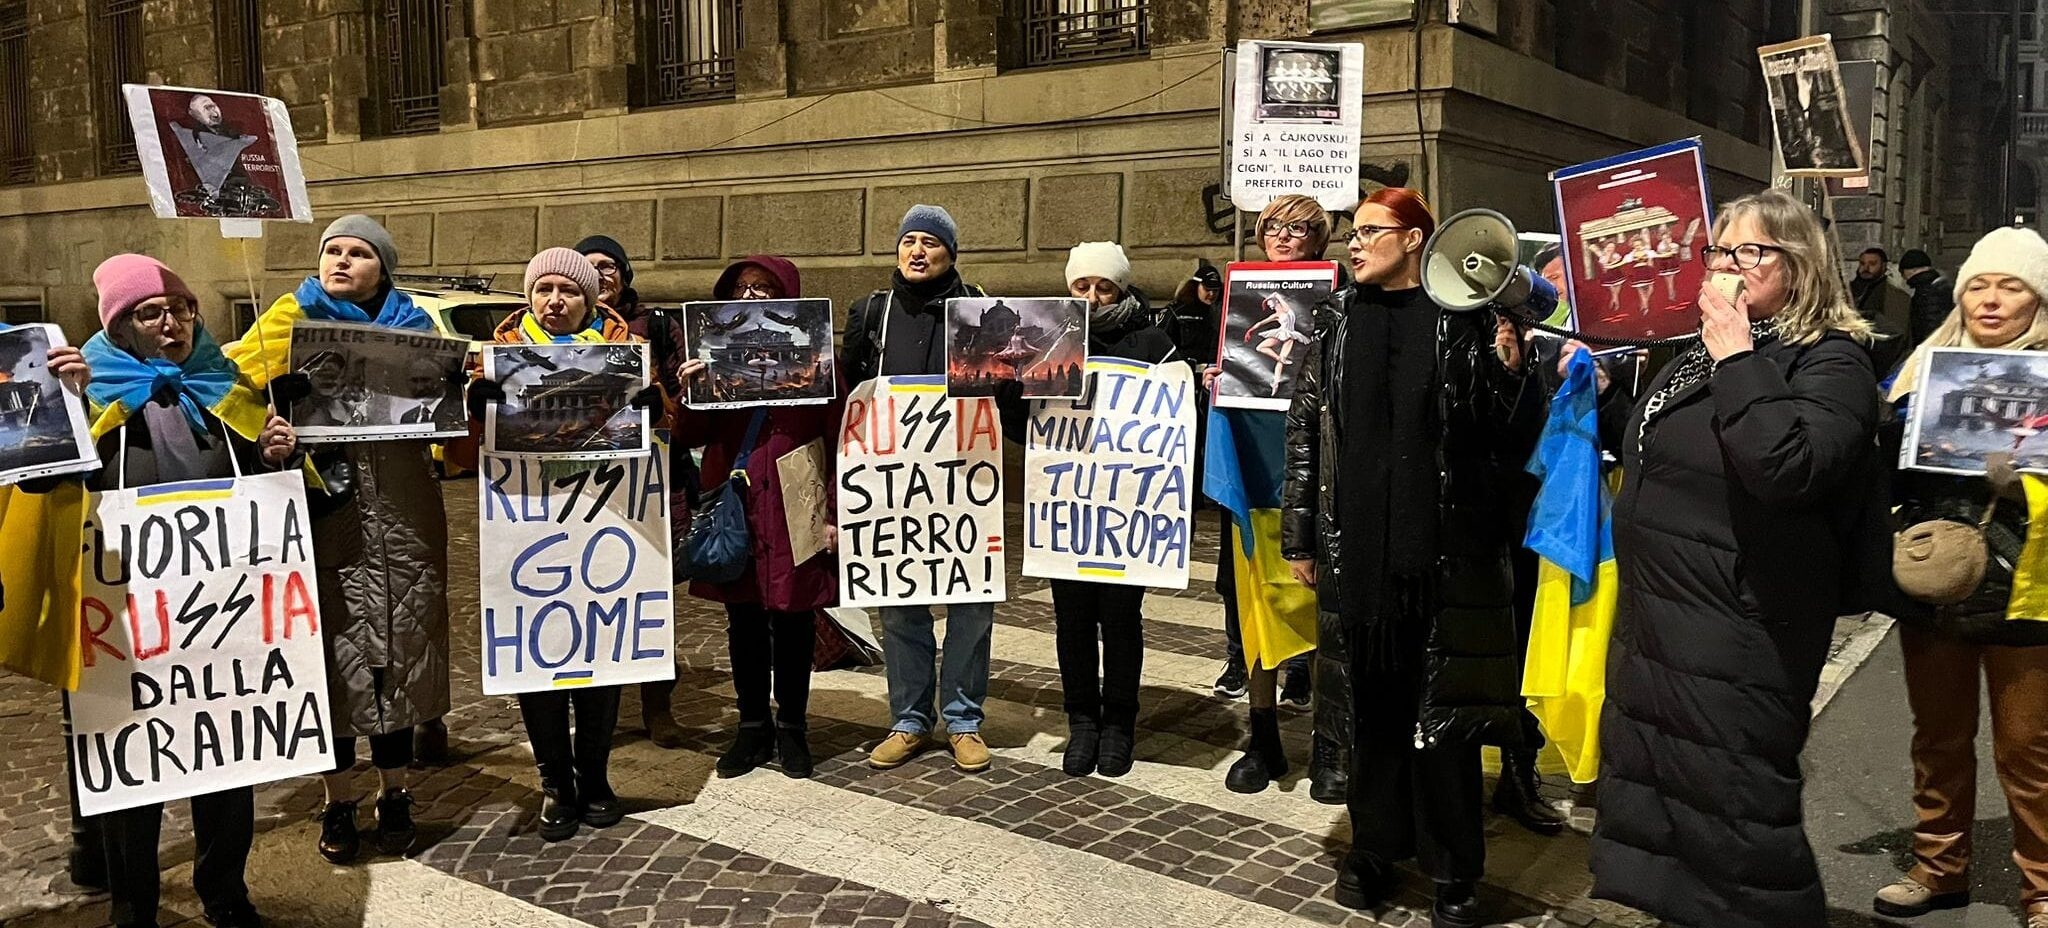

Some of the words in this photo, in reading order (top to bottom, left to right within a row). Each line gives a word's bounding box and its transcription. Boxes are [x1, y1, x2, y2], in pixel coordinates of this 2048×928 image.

[1259, 149, 1267, 157] A
[1294, 149, 1324, 158] LAGO
[1330, 150, 1348, 159] DEI
[1263, 133, 1271, 142] A
[1245, 180, 1303, 188] PREFERITO
[1312, 180, 1344, 189] DEGLI
[1283, 164, 1292, 172] IL
[1298, 165, 1353, 174] BALLETTO
[1245, 281, 1280, 289] Russian
[1281, 281, 1313, 289] Culture
[293, 327, 367, 345] HITLER
[395, 332, 459, 352] PUTIN
[1040, 371, 1186, 418] UTIN
[1030, 416, 1187, 464] MINACCIA
[841, 459, 999, 514] STATO
[1043, 462, 1186, 511] TUTTA
[248, 498, 306, 567] LA
[1029, 500, 1187, 569] L'EUROPA
[511, 526, 636, 597] GO
[485, 591, 668, 677] HOME
[131, 648, 294, 711] DALLA
[77, 692, 327, 793] UCRAINA
